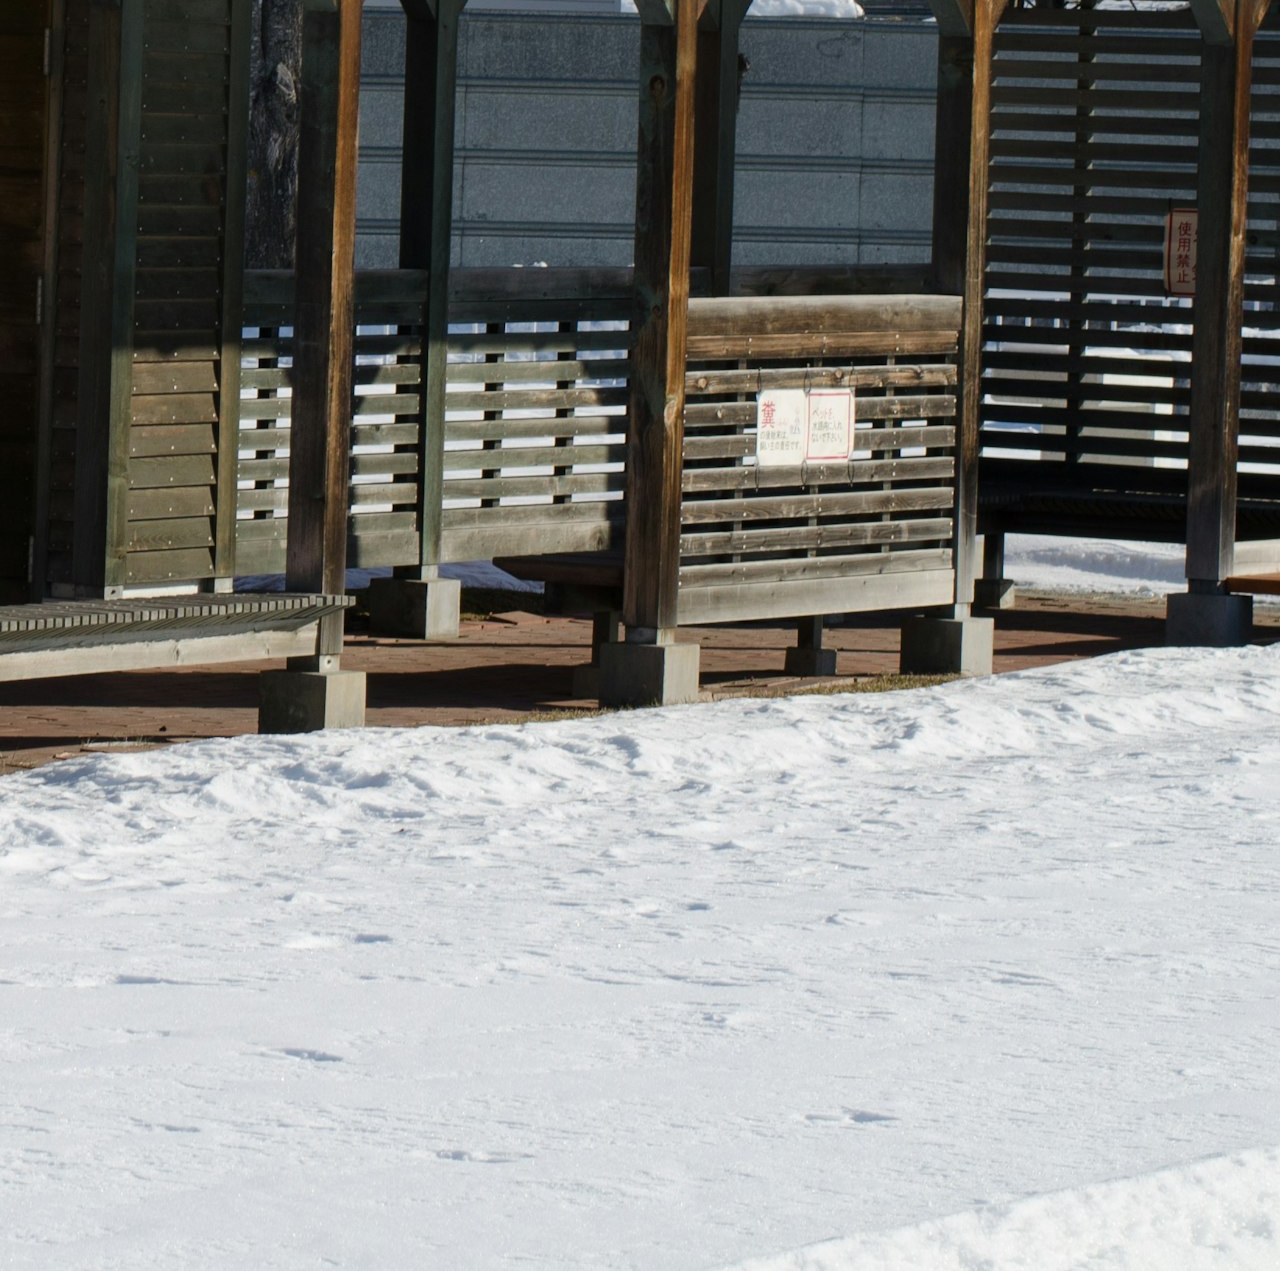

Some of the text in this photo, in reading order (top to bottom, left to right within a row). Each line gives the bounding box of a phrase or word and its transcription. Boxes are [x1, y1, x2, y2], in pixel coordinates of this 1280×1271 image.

[1176, 221, 1193, 284] 使用禁止
[761, 400, 776, 429] 糞
